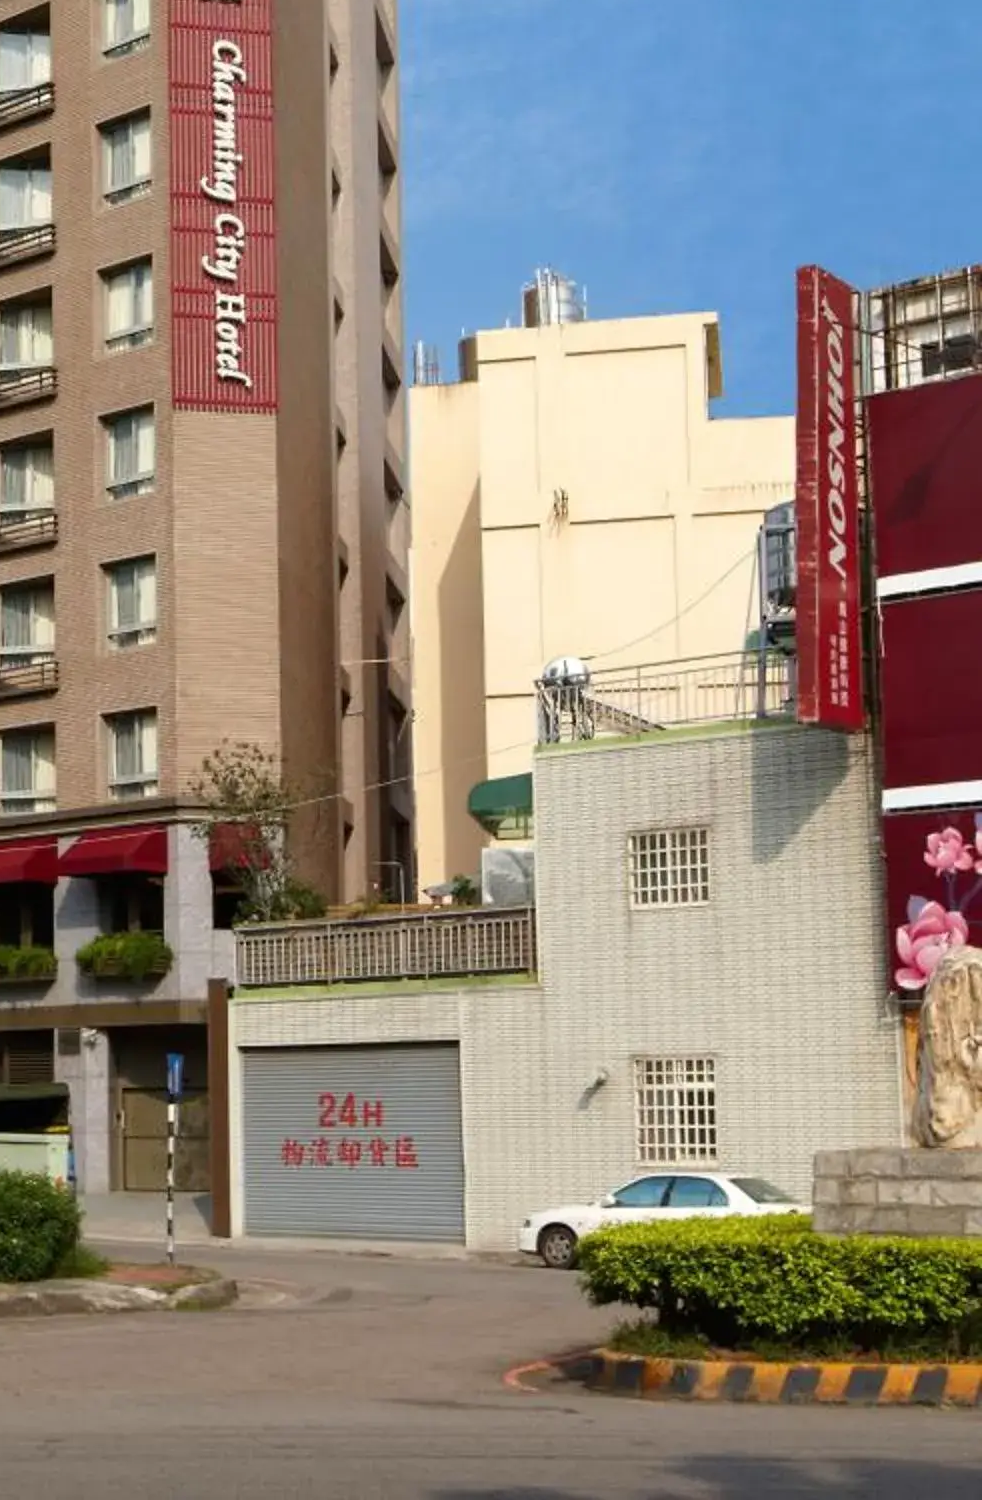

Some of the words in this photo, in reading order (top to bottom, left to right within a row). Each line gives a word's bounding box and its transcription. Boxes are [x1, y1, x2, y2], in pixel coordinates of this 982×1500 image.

[199, 38, 247, 203] Charming
[202, 212, 246, 280] City
[214, 292, 251, 385] Hotel
[821, 299, 847, 580] JOHNSON
[318, 1091, 385, 1128] 24H
[281, 1135, 419, 1170] 物流卸貨區
